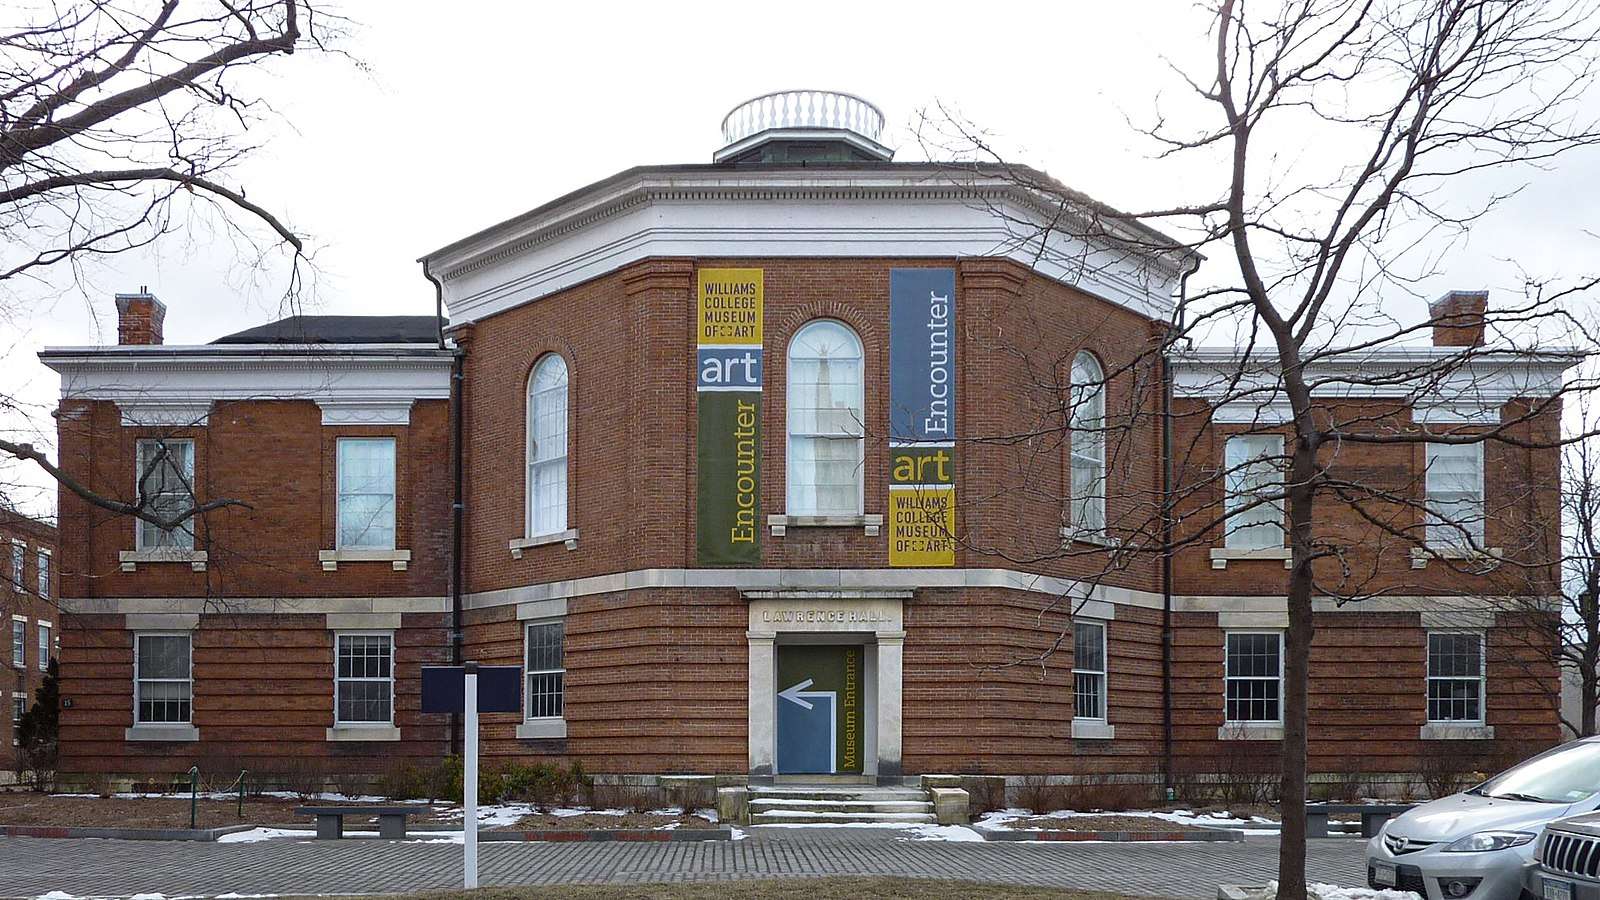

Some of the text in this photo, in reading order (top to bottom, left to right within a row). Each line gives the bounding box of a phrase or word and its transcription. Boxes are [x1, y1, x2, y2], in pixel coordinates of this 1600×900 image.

[704, 282, 756, 295] WILLIAMS
[704, 297, 756, 309] COLLEGE
[704, 311, 756, 323] MUSEUM
[704, 325, 755, 337] OF ART
[701, 352, 757, 383] art
[925, 290, 948, 434] Encounter
[730, 399, 755, 544] Encounter
[893, 450, 950, 481] art
[896, 497, 948, 509] WILLIAMS
[896, 511, 948, 523] COLLEGE
[896, 525, 948, 538] MUSEUM
[896, 540, 948, 552] OF ART
[762, 610, 845, 623] LAWRENCE
[844, 649, 856, 768] Museum Entrance
